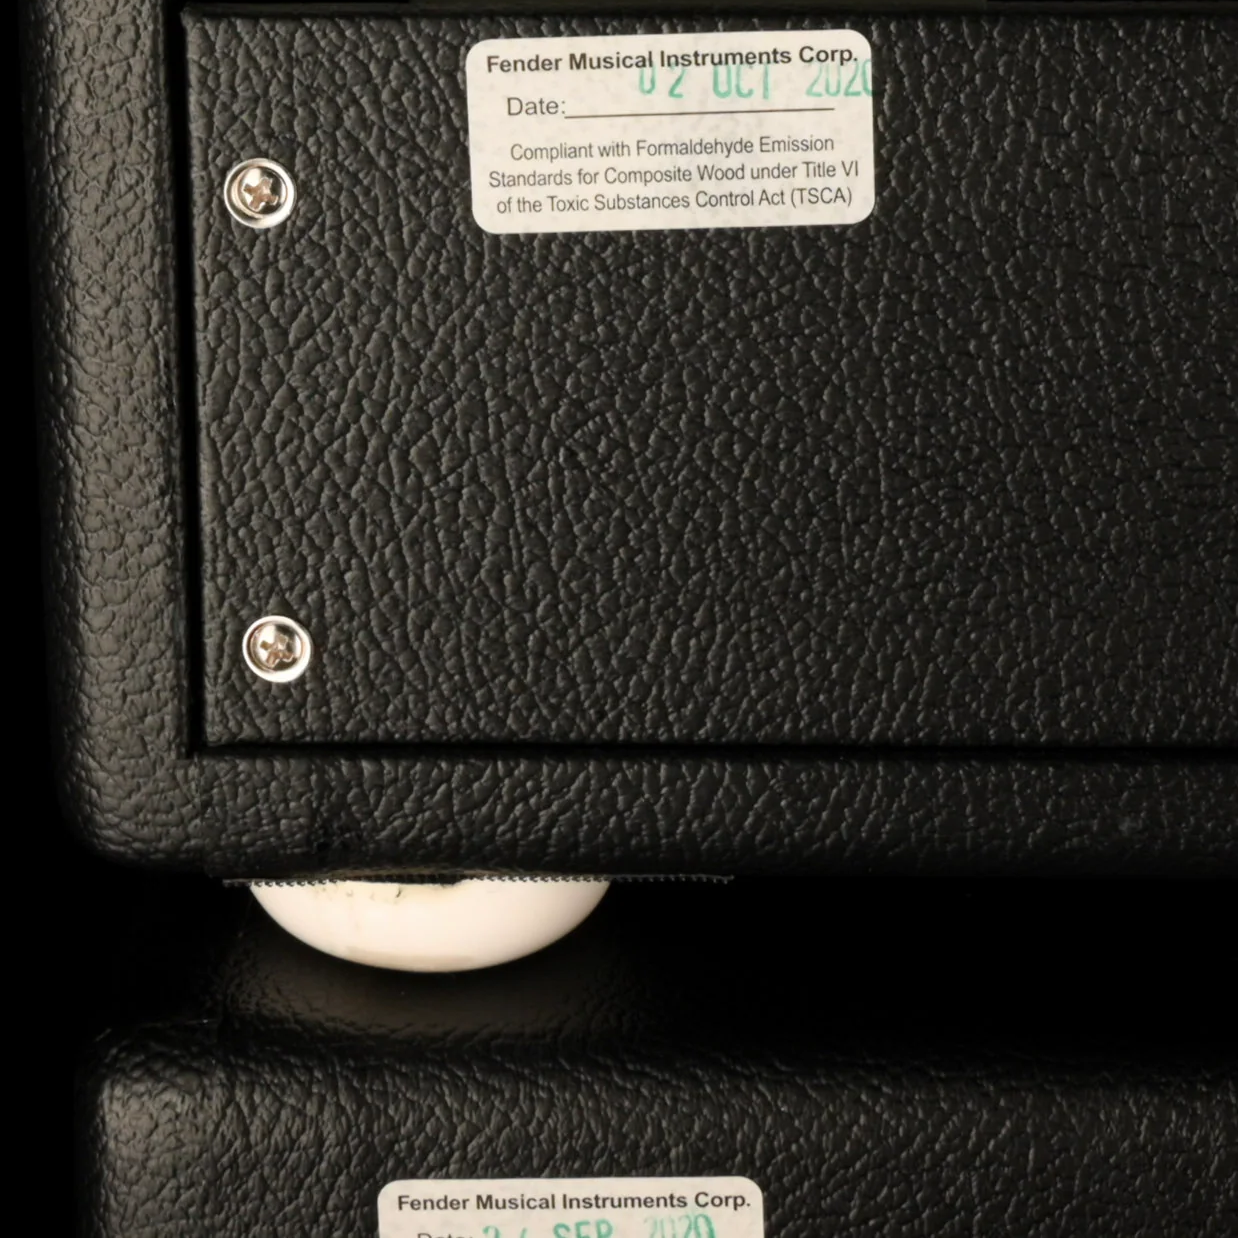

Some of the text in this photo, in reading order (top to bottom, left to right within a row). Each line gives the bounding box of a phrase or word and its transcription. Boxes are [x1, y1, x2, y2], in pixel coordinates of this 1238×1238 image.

[487, 46, 857, 72] Fender Musical Instruments Corp.
[507, 96, 566, 117] Date:
[511, 136, 834, 163] Compliant with Formaldehyde Emission
[489, 161, 858, 188] Standards for Composite Wood under Title VI
[497, 187, 851, 214] of the Toxic Substances Control Act (TSCA)
[398, 1192, 750, 1211] Fender Musical Instruments Corp.
